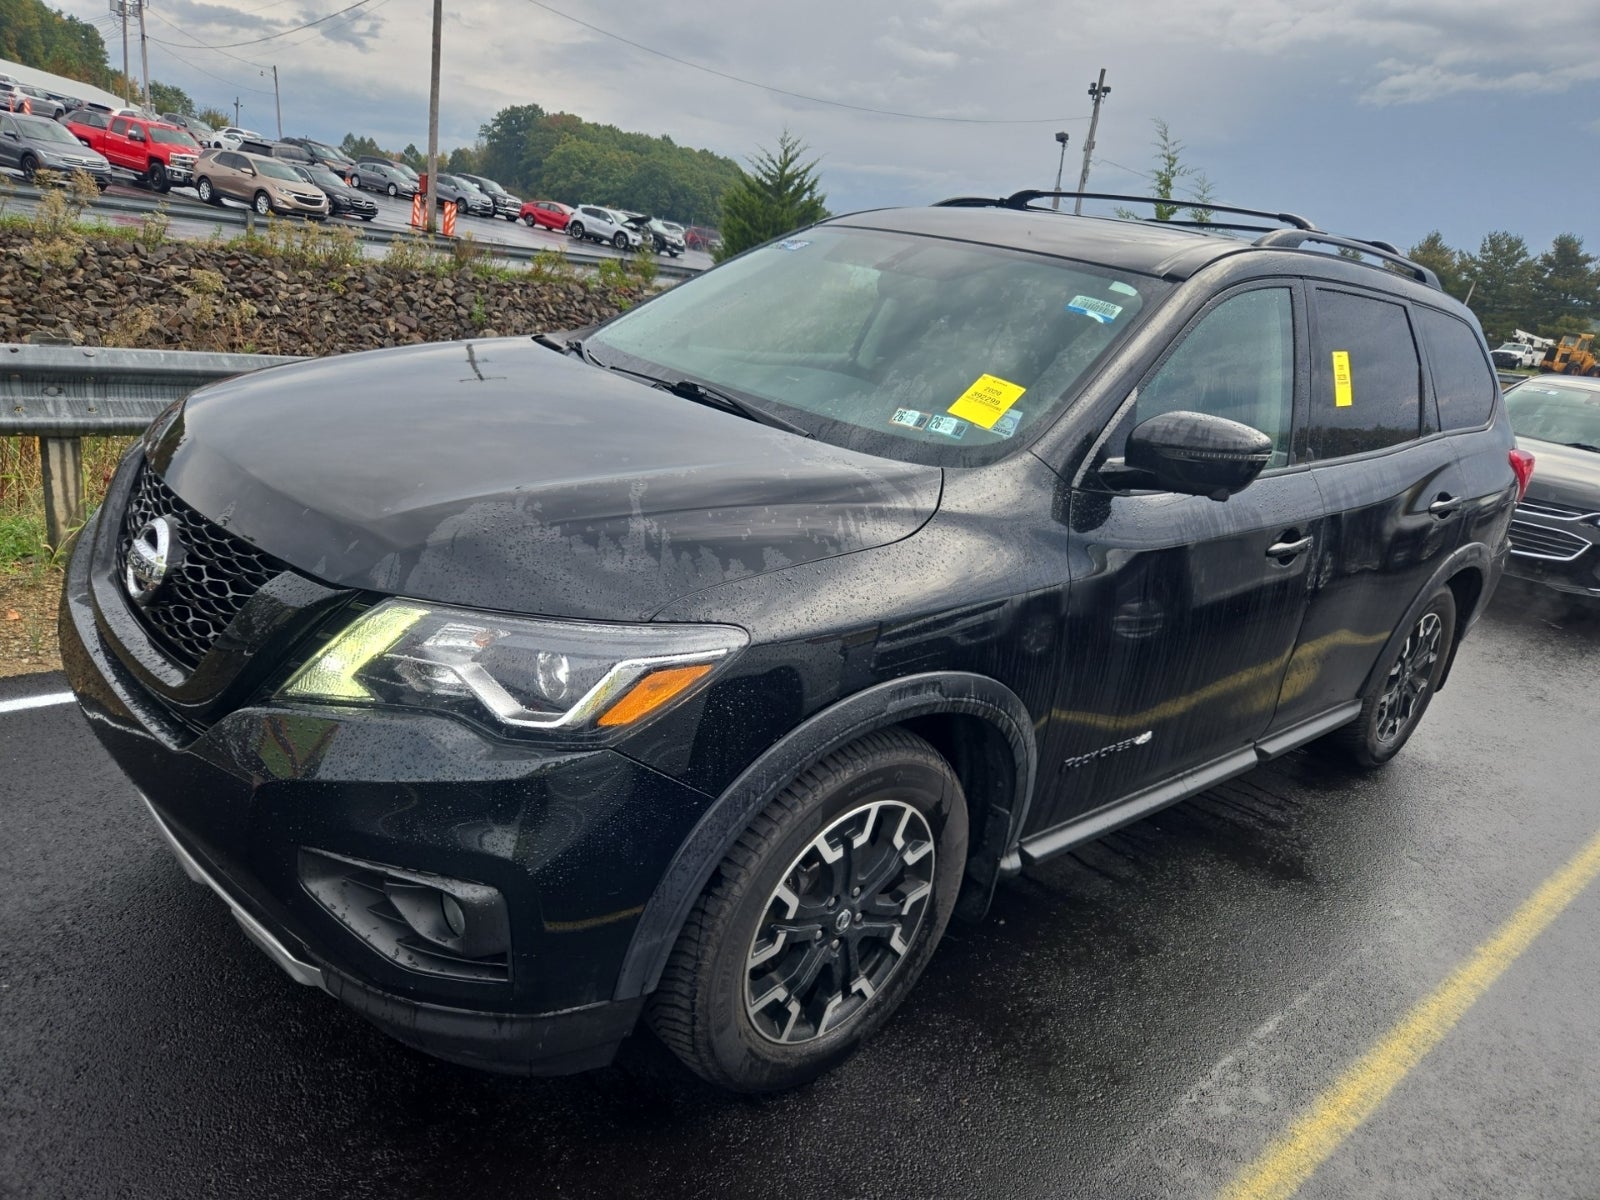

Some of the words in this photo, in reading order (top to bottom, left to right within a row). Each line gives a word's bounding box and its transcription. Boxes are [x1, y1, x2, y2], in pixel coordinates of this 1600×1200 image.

[984, 386, 1002, 397] 2020
[972, 391, 1001, 406] 392299
[893, 410, 906, 422] 26
[930, 416, 944, 430] 26
